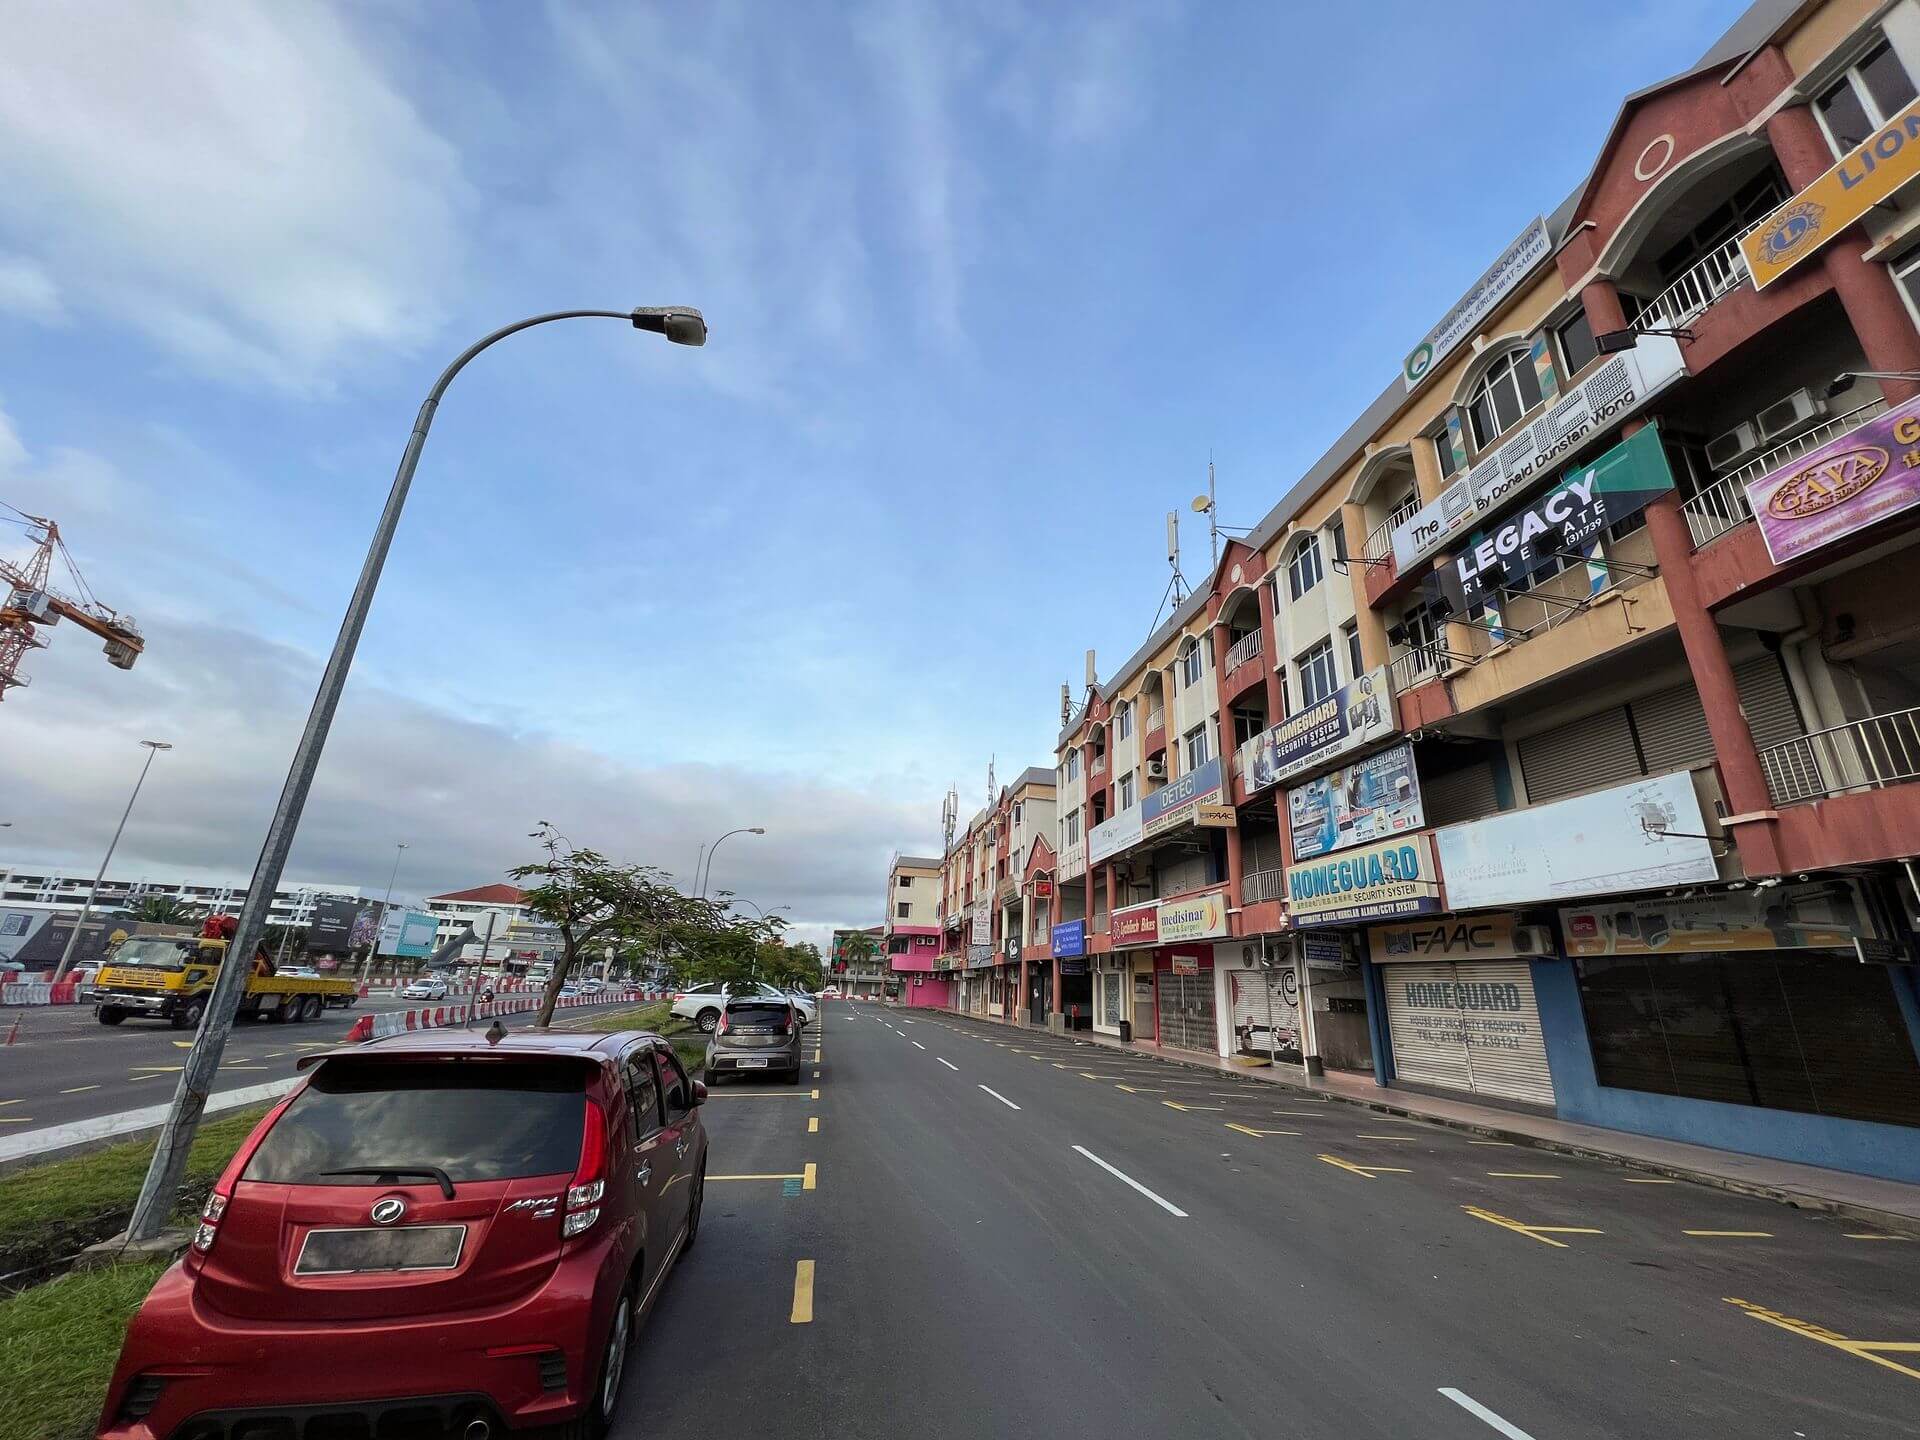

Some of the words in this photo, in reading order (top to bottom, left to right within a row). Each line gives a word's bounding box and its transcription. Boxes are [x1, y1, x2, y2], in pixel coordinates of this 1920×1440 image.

[1486, 226, 1543, 287] ASSOCIATION
[1476, 498, 1491, 512] By
[1491, 465, 1532, 501] Donald
[1535, 424, 1590, 470] Dunstan
[1590, 390, 1636, 427] Wong
[1775, 453, 1879, 512] GAYA
[1412, 519, 1439, 546] The
[1456, 469, 1595, 583] LEGACY
[1275, 699, 1338, 746] HOMEGUARD
[1277, 733, 1308, 758] SECURITY
[1309, 718, 1340, 741] SYSTEM
[1353, 746, 1406, 776] HOMEGUARD
[1161, 779, 1193, 807] DETEC
[1209, 811, 1233, 820] FAAC
[1289, 845, 1419, 901] HOMEGUARD
[1353, 888, 1386, 903] SECURITY
[1387, 883, 1417, 897] SYSTEM
[1161, 909, 1204, 926] medisinar
[1412, 924, 1496, 954] FAAC
[1405, 982, 1521, 1011] HOMEGUARD
